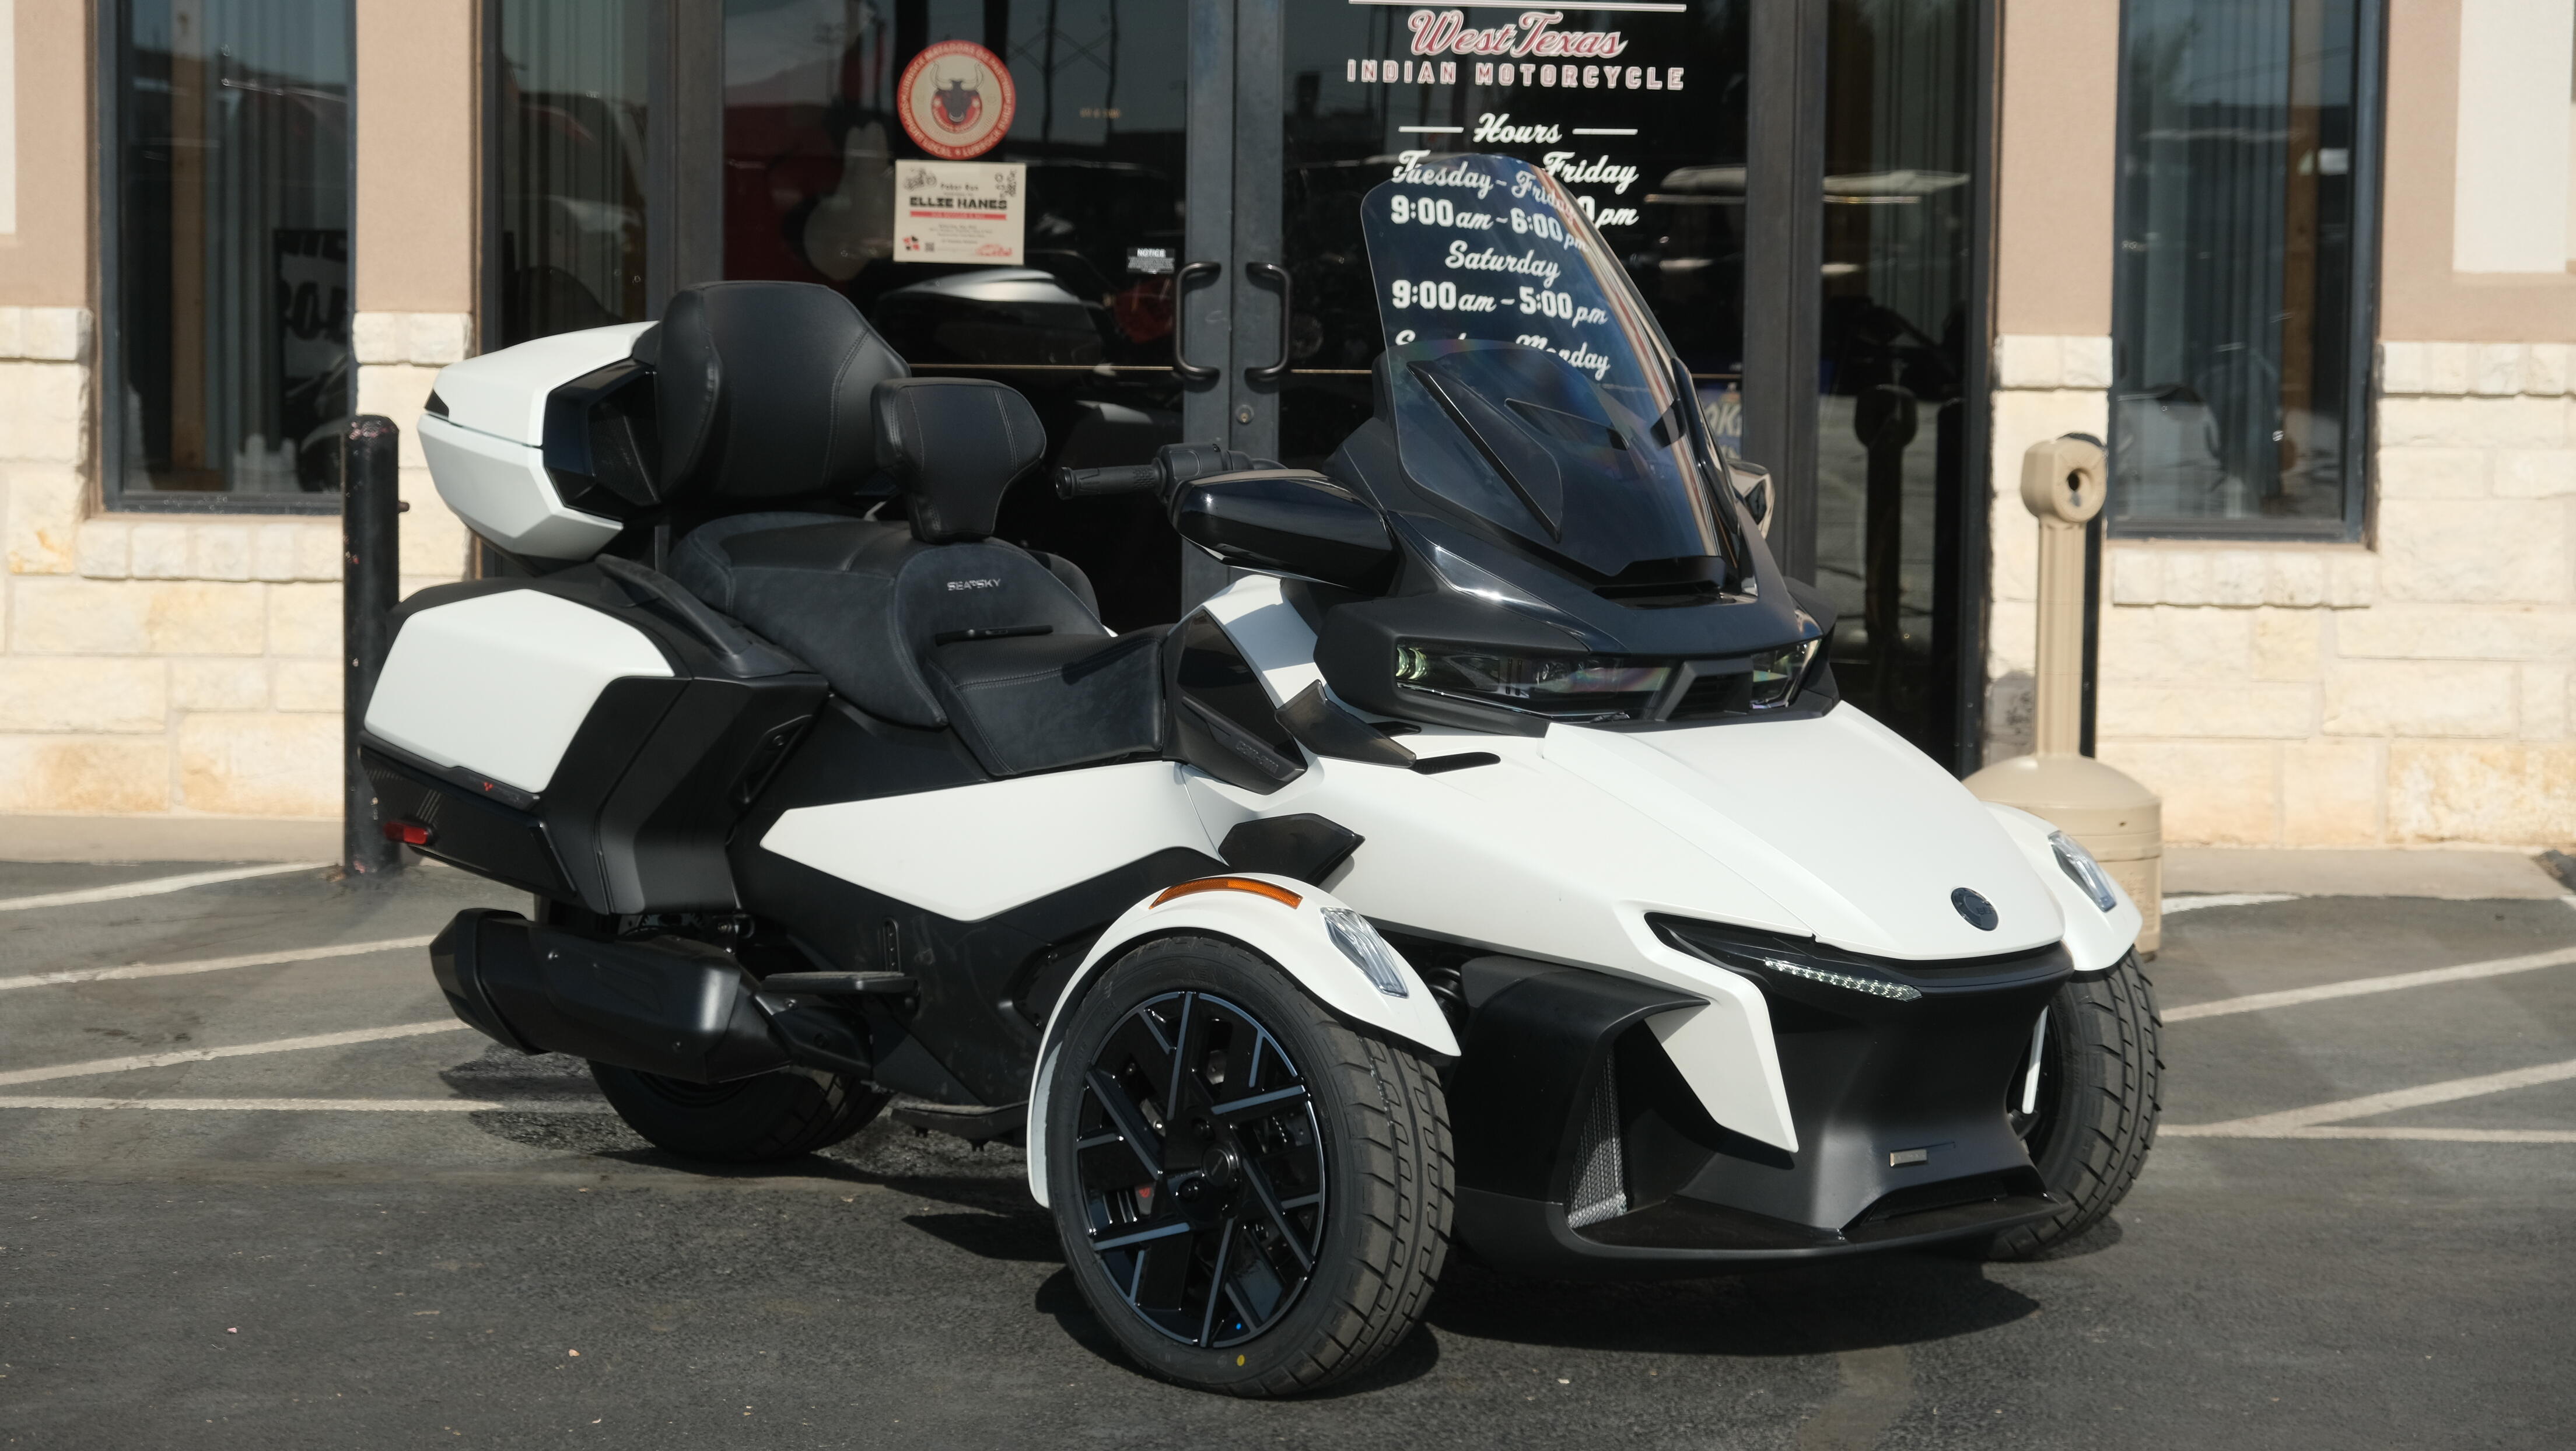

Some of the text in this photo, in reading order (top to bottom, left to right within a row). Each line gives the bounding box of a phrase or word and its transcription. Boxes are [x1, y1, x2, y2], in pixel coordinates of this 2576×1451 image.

[1408, 9, 1629, 59] West Texas
[1347, 59, 1685, 91] INDIAN MOTORCYCLE
[1472, 113, 1563, 144] Hours
[1392, 149, 1494, 199] Tuesday
[1543, 151, 1640, 195] Friday
[909, 196, 1007, 210] ELLIE HANES
[1137, 248, 1167, 257] NOTICE
[1444, 240, 1562, 288] Saturday
